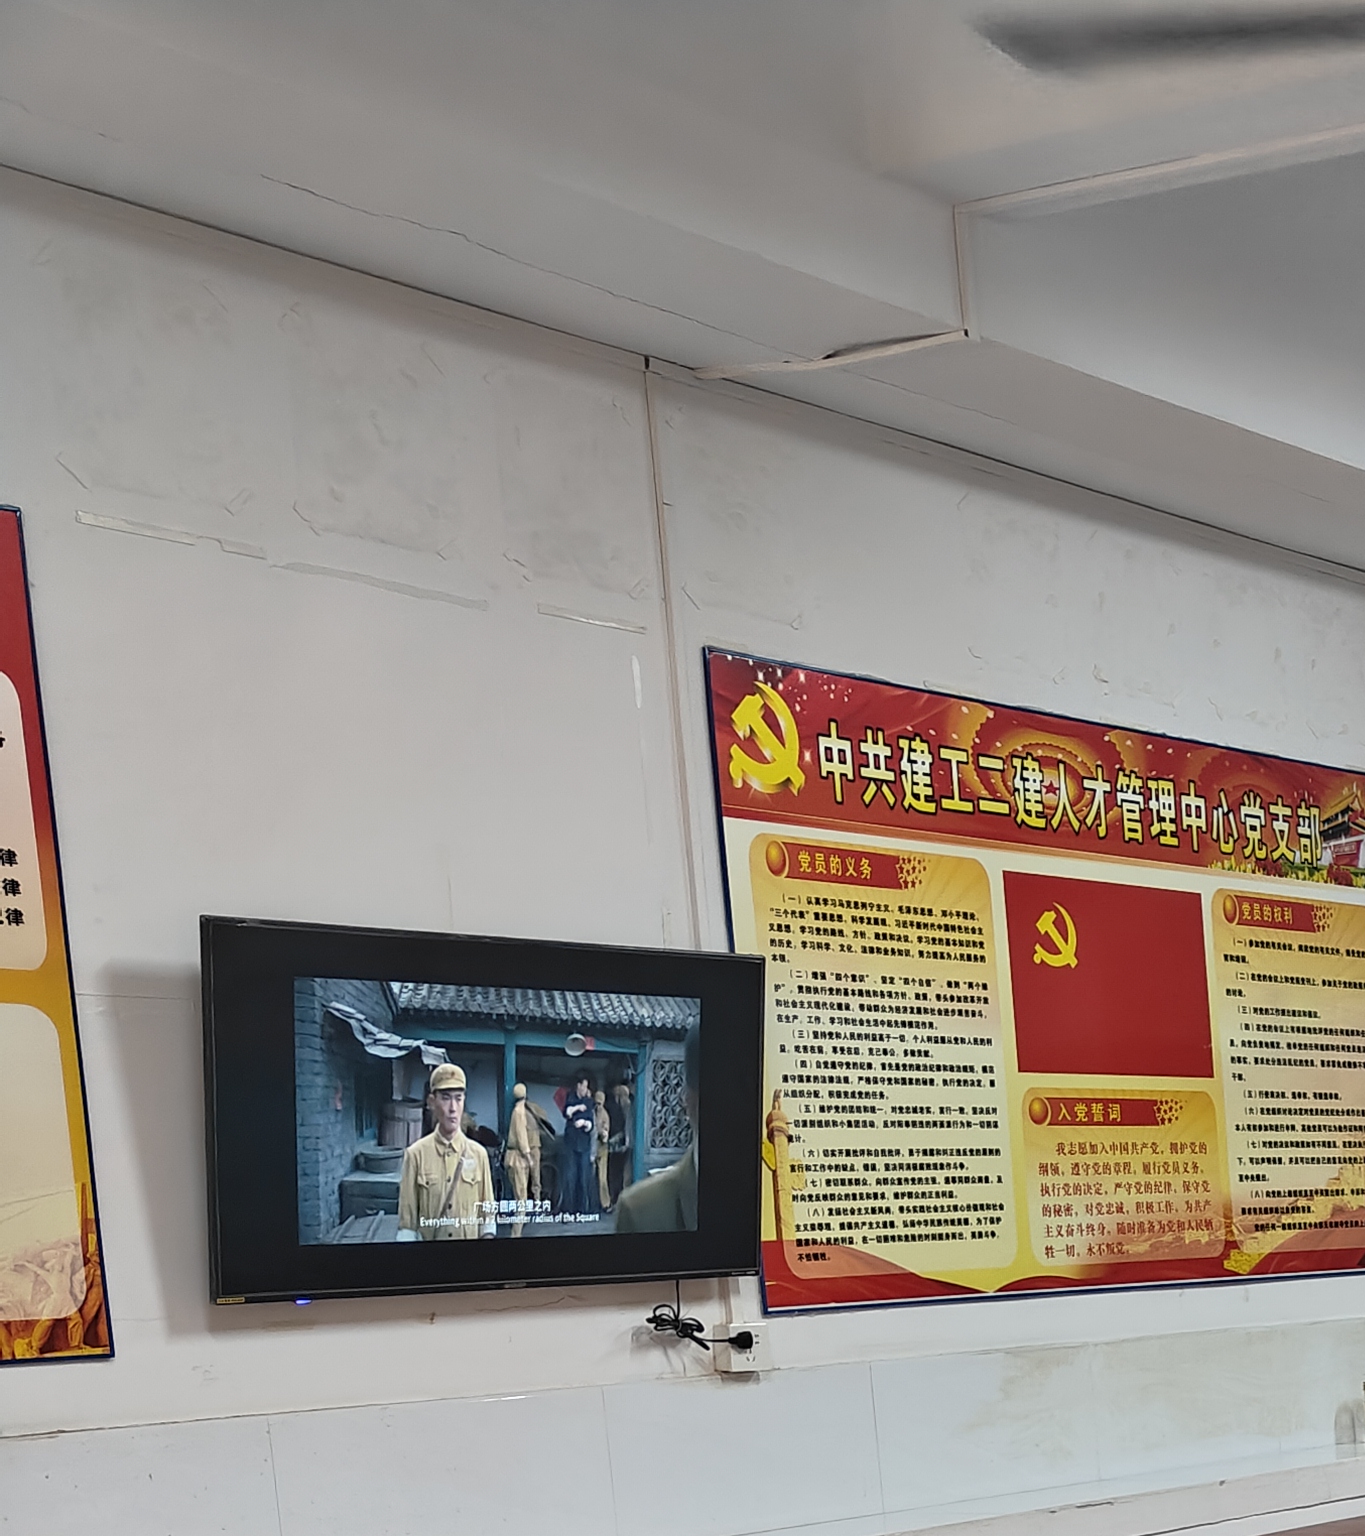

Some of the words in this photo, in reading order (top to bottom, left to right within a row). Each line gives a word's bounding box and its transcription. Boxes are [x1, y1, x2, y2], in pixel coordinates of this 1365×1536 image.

[817, 721, 1324, 869] 中共建工二建人才管理中心党支部
[798, 848, 874, 881] 党员的义务
[1241, 903, 1293, 925] 党员的权利
[1058, 1102, 1121, 1123] 入党誓词
[473, 1199, 551, 1213] 广场方圆两公里之内
[419, 1215, 460, 1228] Everything
[532, 1213, 553, 1223] radius
[563, 1212, 574, 1222] the
[575, 1211, 600, 1223] Square
